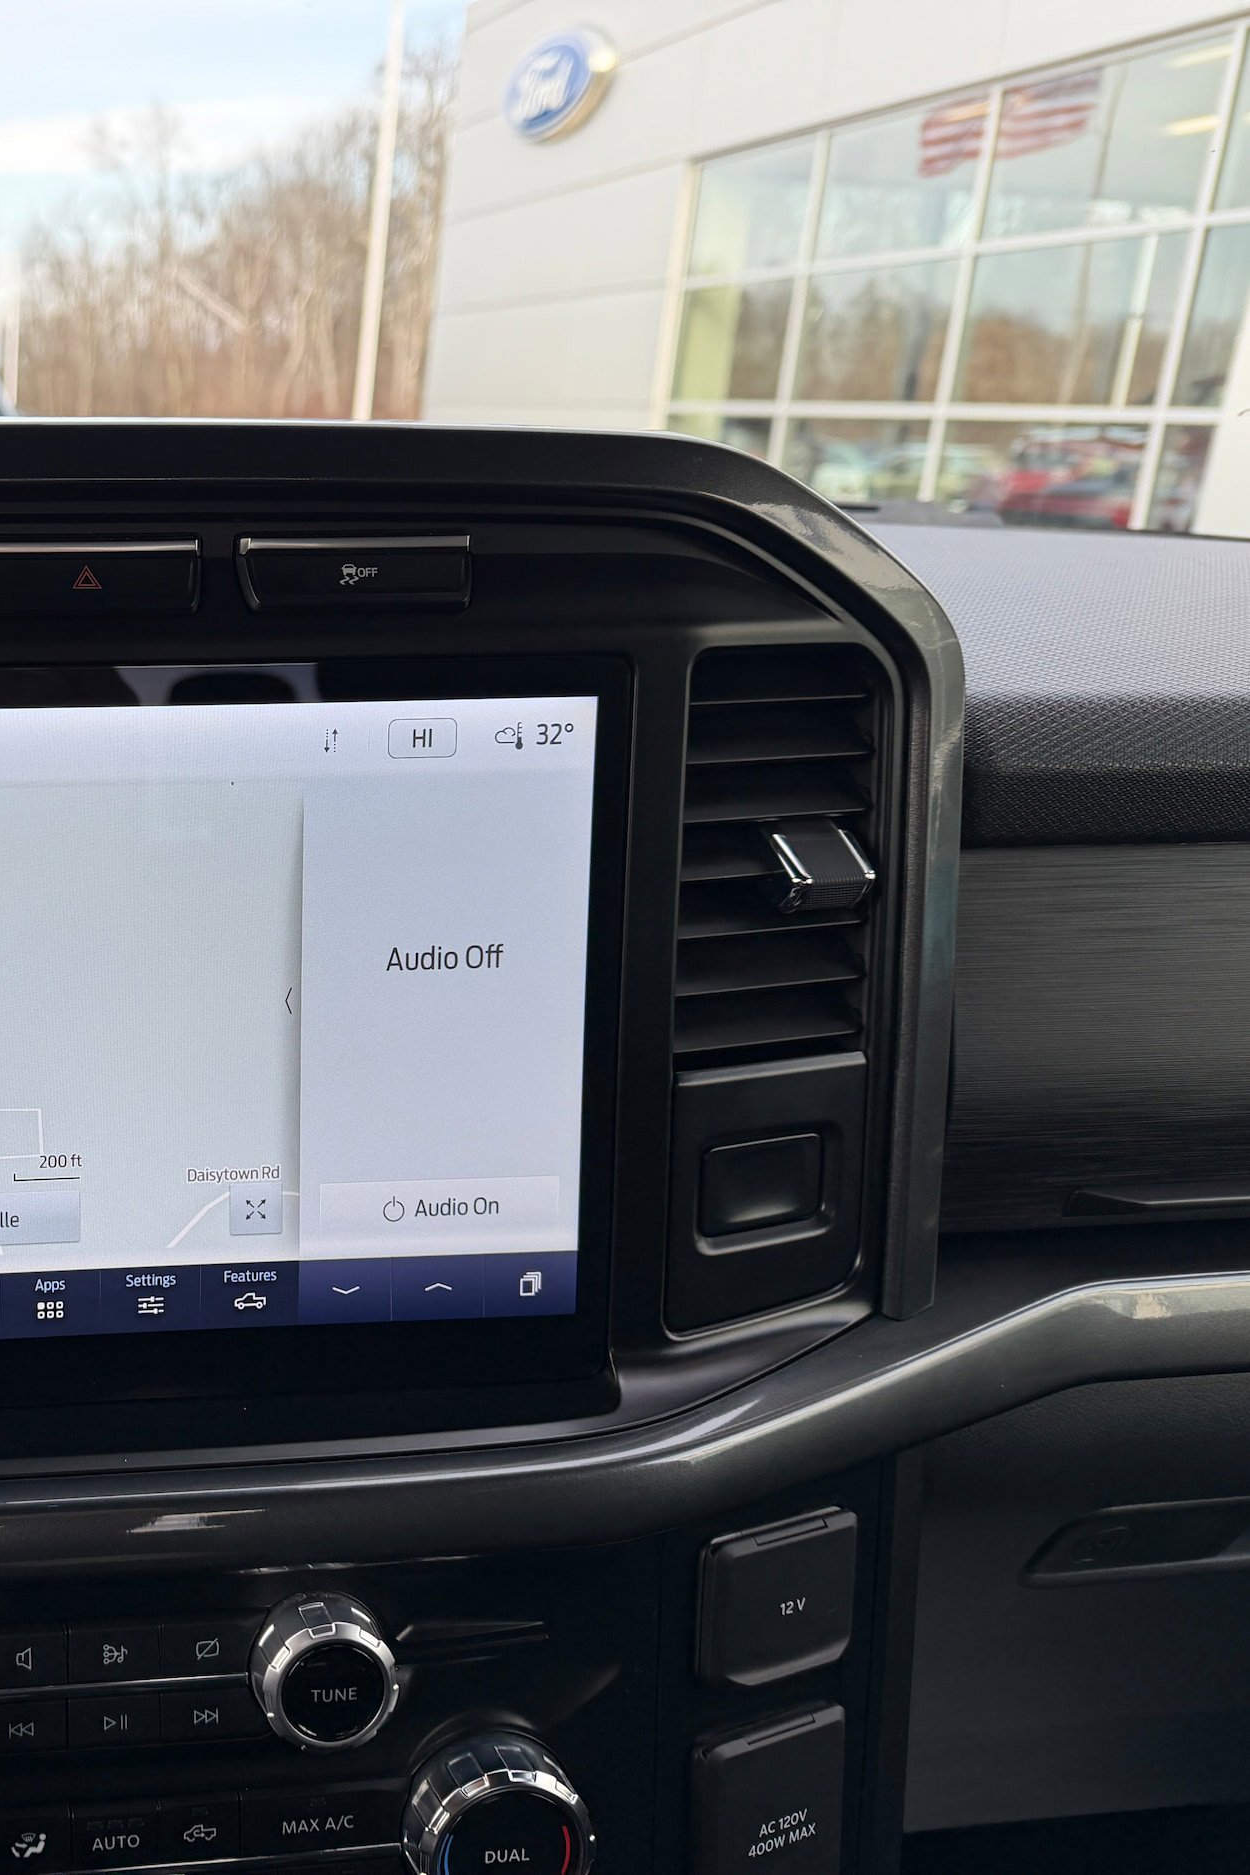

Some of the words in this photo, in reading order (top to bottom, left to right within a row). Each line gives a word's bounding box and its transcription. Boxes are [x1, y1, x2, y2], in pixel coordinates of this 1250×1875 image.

[355, 567, 378, 580] OFF
[412, 728, 433, 748] HI
[536, 722, 574, 746] 32°
[386, 945, 459, 972] Audio
[465, 943, 504, 969] Off
[39, 1154, 67, 1169] 200
[70, 1153, 83, 1168] ft
[187, 1168, 259, 1184] Daisytown
[262, 1165, 280, 1179] Rd
[414, 1197, 469, 1217] Audio
[473, 1196, 499, 1215] On
[125, 1273, 177, 1288] Settings
[223, 1269, 277, 1283] Features
[34, 1278, 66, 1294] Apps
[780, 1600, 794, 1616] 12
[796, 1597, 806, 1611] V
[310, 1686, 358, 1703] TUNE
[282, 1818, 320, 1835] MAX
[324, 1815, 354, 1831] A/C
[759, 1821, 776, 1838] AC
[778, 1808, 808, 1830] 120V
[92, 1834, 140, 1852] AUTO
[748, 1834, 786, 1857] 400W
[789, 1822, 816, 1844] MAX
[484, 1847, 530, 1864] DUAL
